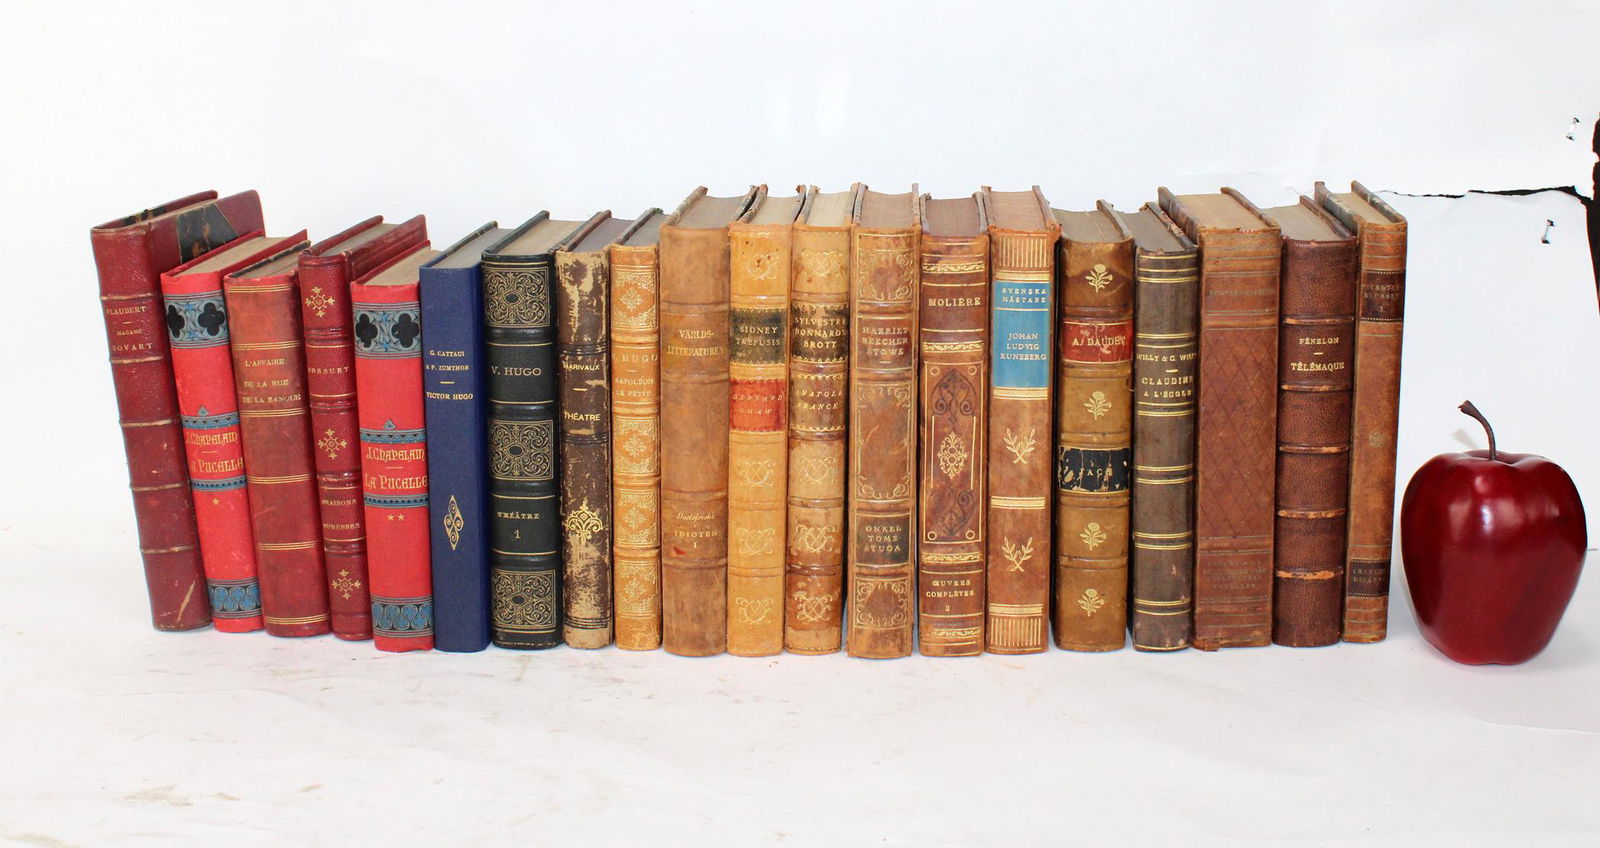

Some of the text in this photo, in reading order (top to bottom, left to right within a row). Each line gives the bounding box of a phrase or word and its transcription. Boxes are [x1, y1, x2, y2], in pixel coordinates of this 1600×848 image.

[1001, 287, 1047, 295] SVENSKA
[106, 305, 147, 315] FLAUBERT
[739, 326, 779, 335] SIDNEY
[736, 337, 781, 346] TREFUSIS
[1008, 333, 1039, 341] JOHAN
[1299, 336, 1340, 345] FÉNELON
[112, 342, 153, 352] BOVARY
[803, 341, 837, 349] BROTT
[1006, 343, 1040, 351] LUDVIG
[622, 353, 658, 363] HUGO
[1000, 353, 1047, 361] RUNEBERG
[245, 358, 286, 367] L'AFFAIRE
[562, 361, 600, 371] MARIVAUX
[1290, 361, 1345, 372] TÉLÉMAQUE
[491, 366, 542, 376] V. HUGO
[243, 380, 254, 388] DE
[271, 379, 289, 387] RUE
[242, 396, 252, 404] DE
[267, 393, 302, 403] BANQUE
[425, 391, 451, 399] VICTOR
[513, 528, 521, 539] 1
[674, 529, 718, 538] IDIOTEN
[865, 525, 902, 533] ONKEL
[868, 535, 898, 543] TOMS
